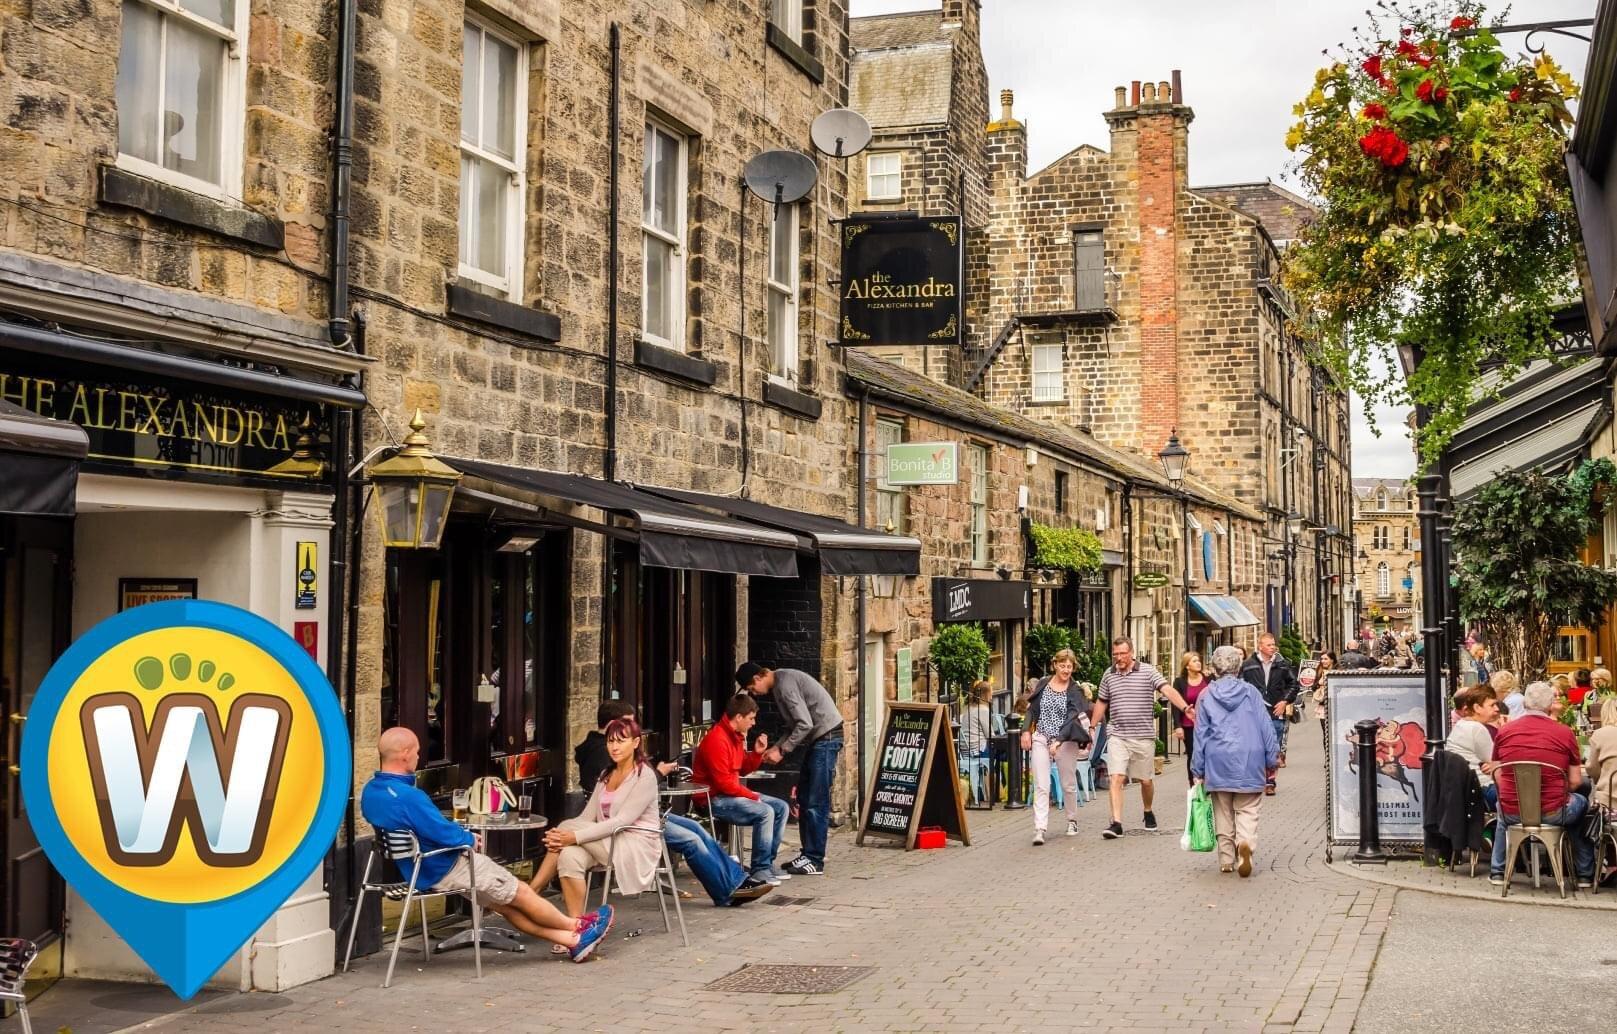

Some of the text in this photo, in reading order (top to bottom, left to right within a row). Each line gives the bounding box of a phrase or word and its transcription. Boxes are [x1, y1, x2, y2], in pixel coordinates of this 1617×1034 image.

[872, 270, 892, 283] the
[844, 276, 956, 299] Alexandra
[0, 374, 291, 451] HE ALEXANDRA
[891, 457, 951, 472] Bonita B
[893, 731, 922, 747] ALL LIVE
[882, 745, 925, 770] FOOTY
[872, 811, 884, 825] BIG
